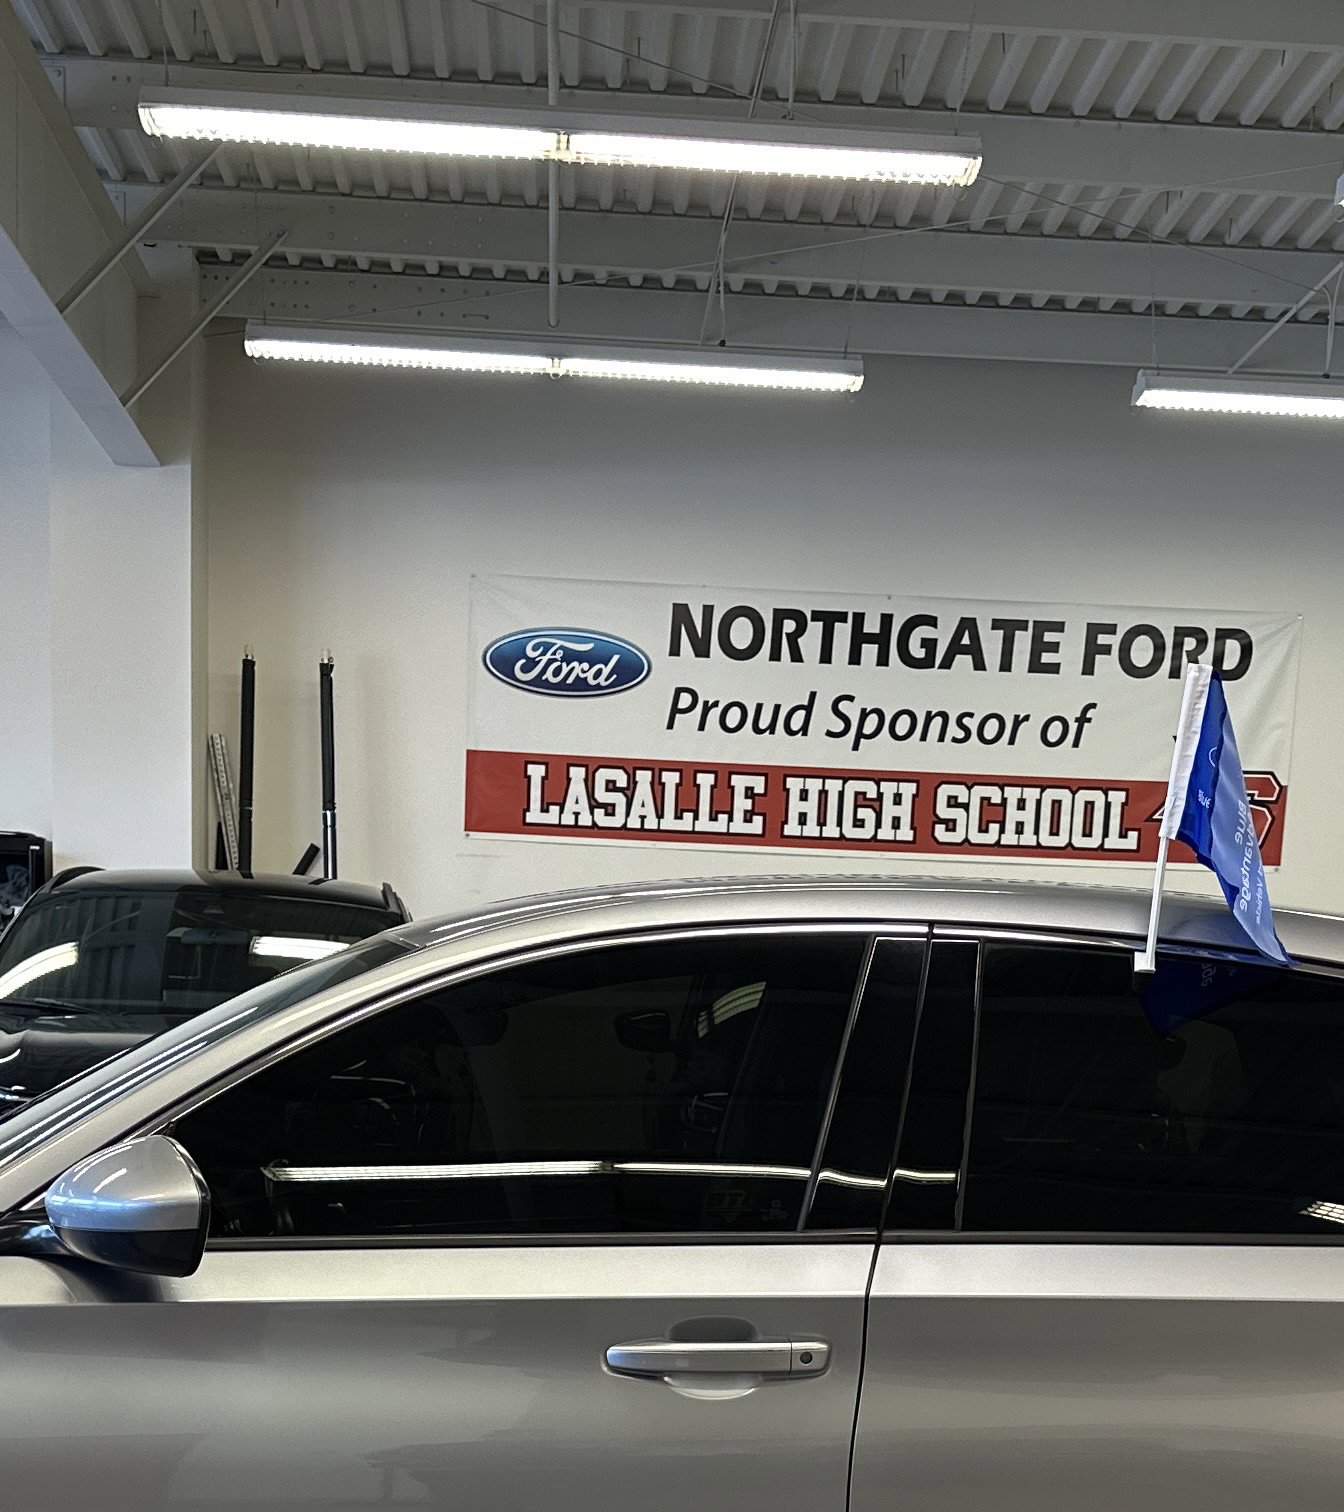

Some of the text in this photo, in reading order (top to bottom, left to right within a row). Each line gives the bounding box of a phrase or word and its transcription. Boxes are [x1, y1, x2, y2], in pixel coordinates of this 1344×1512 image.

[513, 636, 621, 689] Ford
[668, 602, 1253, 682] NORTHGATE FORD
[666, 686, 1098, 752] Proud Sponsor of
[524, 763, 765, 836] LASALLE
[782, 776, 918, 842] HIGH
[933, 783, 1140, 851] SCHOOL
